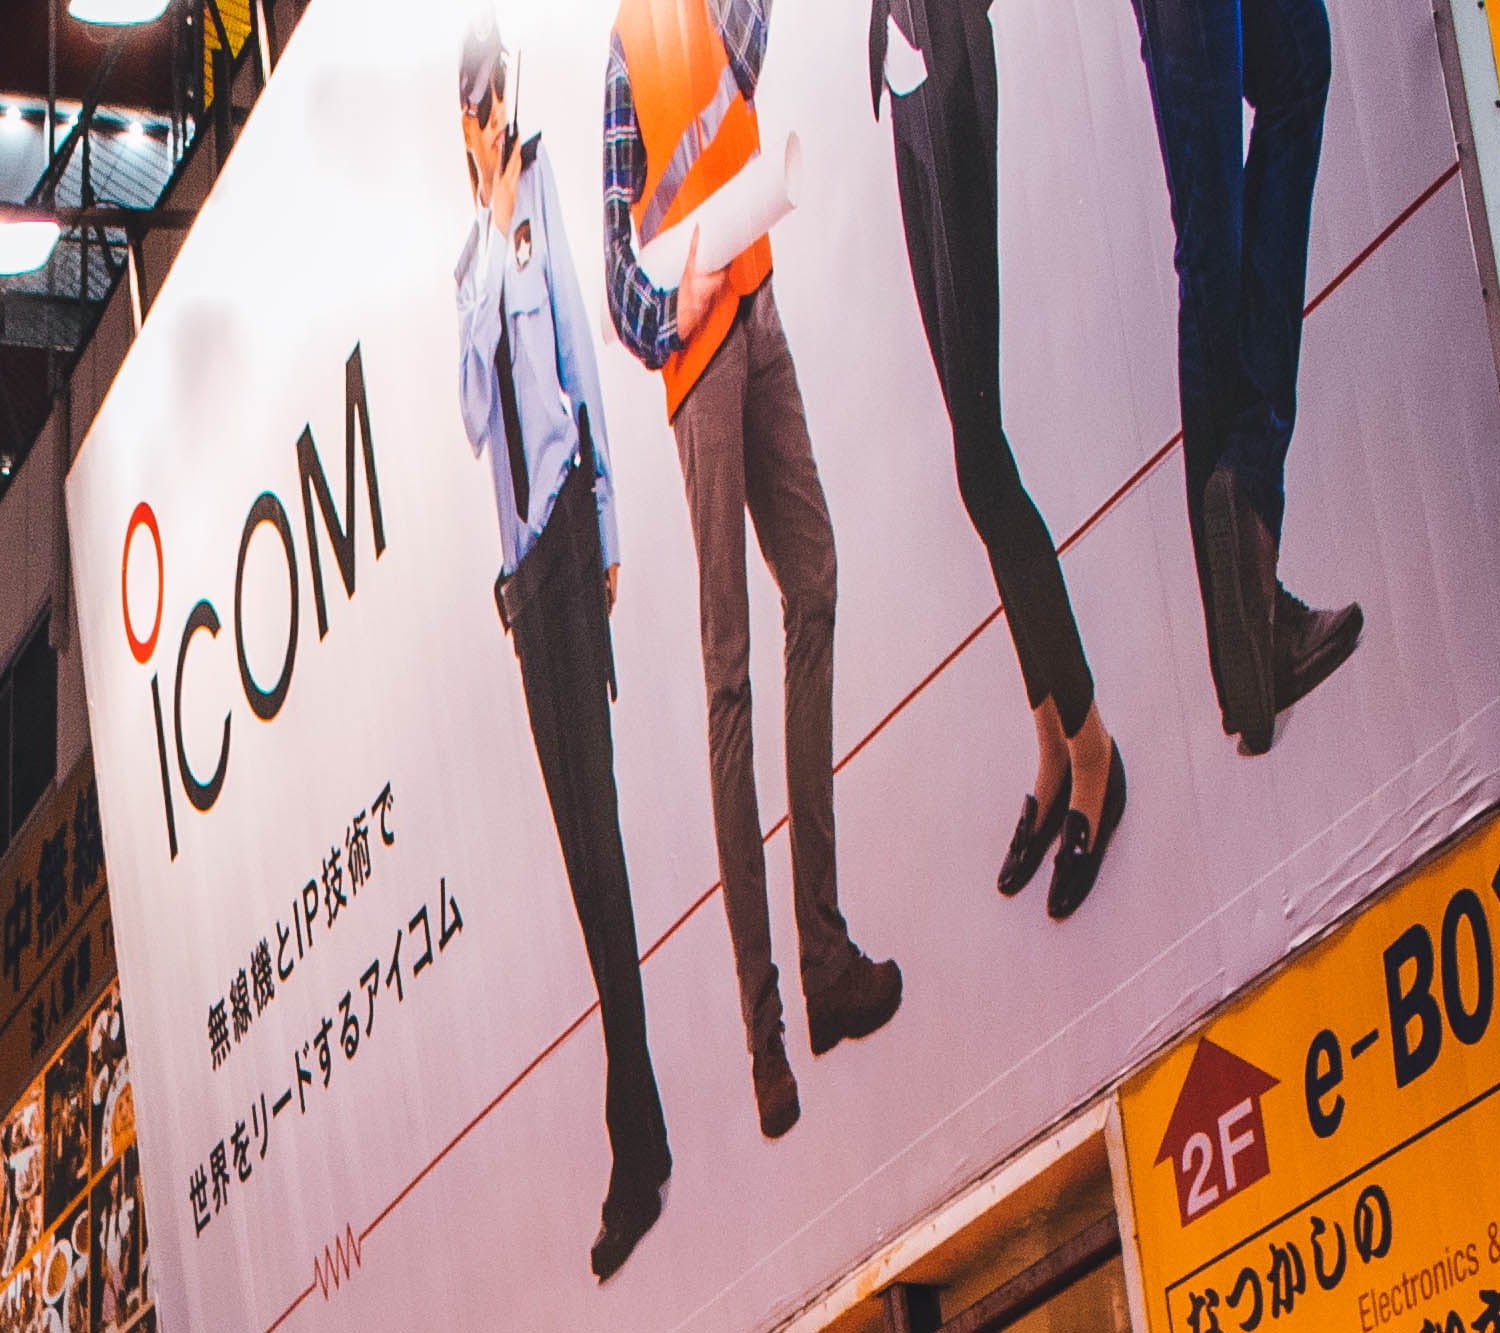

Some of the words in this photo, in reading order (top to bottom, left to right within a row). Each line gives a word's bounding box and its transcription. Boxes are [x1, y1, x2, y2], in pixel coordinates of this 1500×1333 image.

[189, 878, 464, 1239] 世界をリードするアイコム
[207, 780, 396, 1072] 無線機とIP技術で
[1180, 1096, 1256, 1217] 2F
